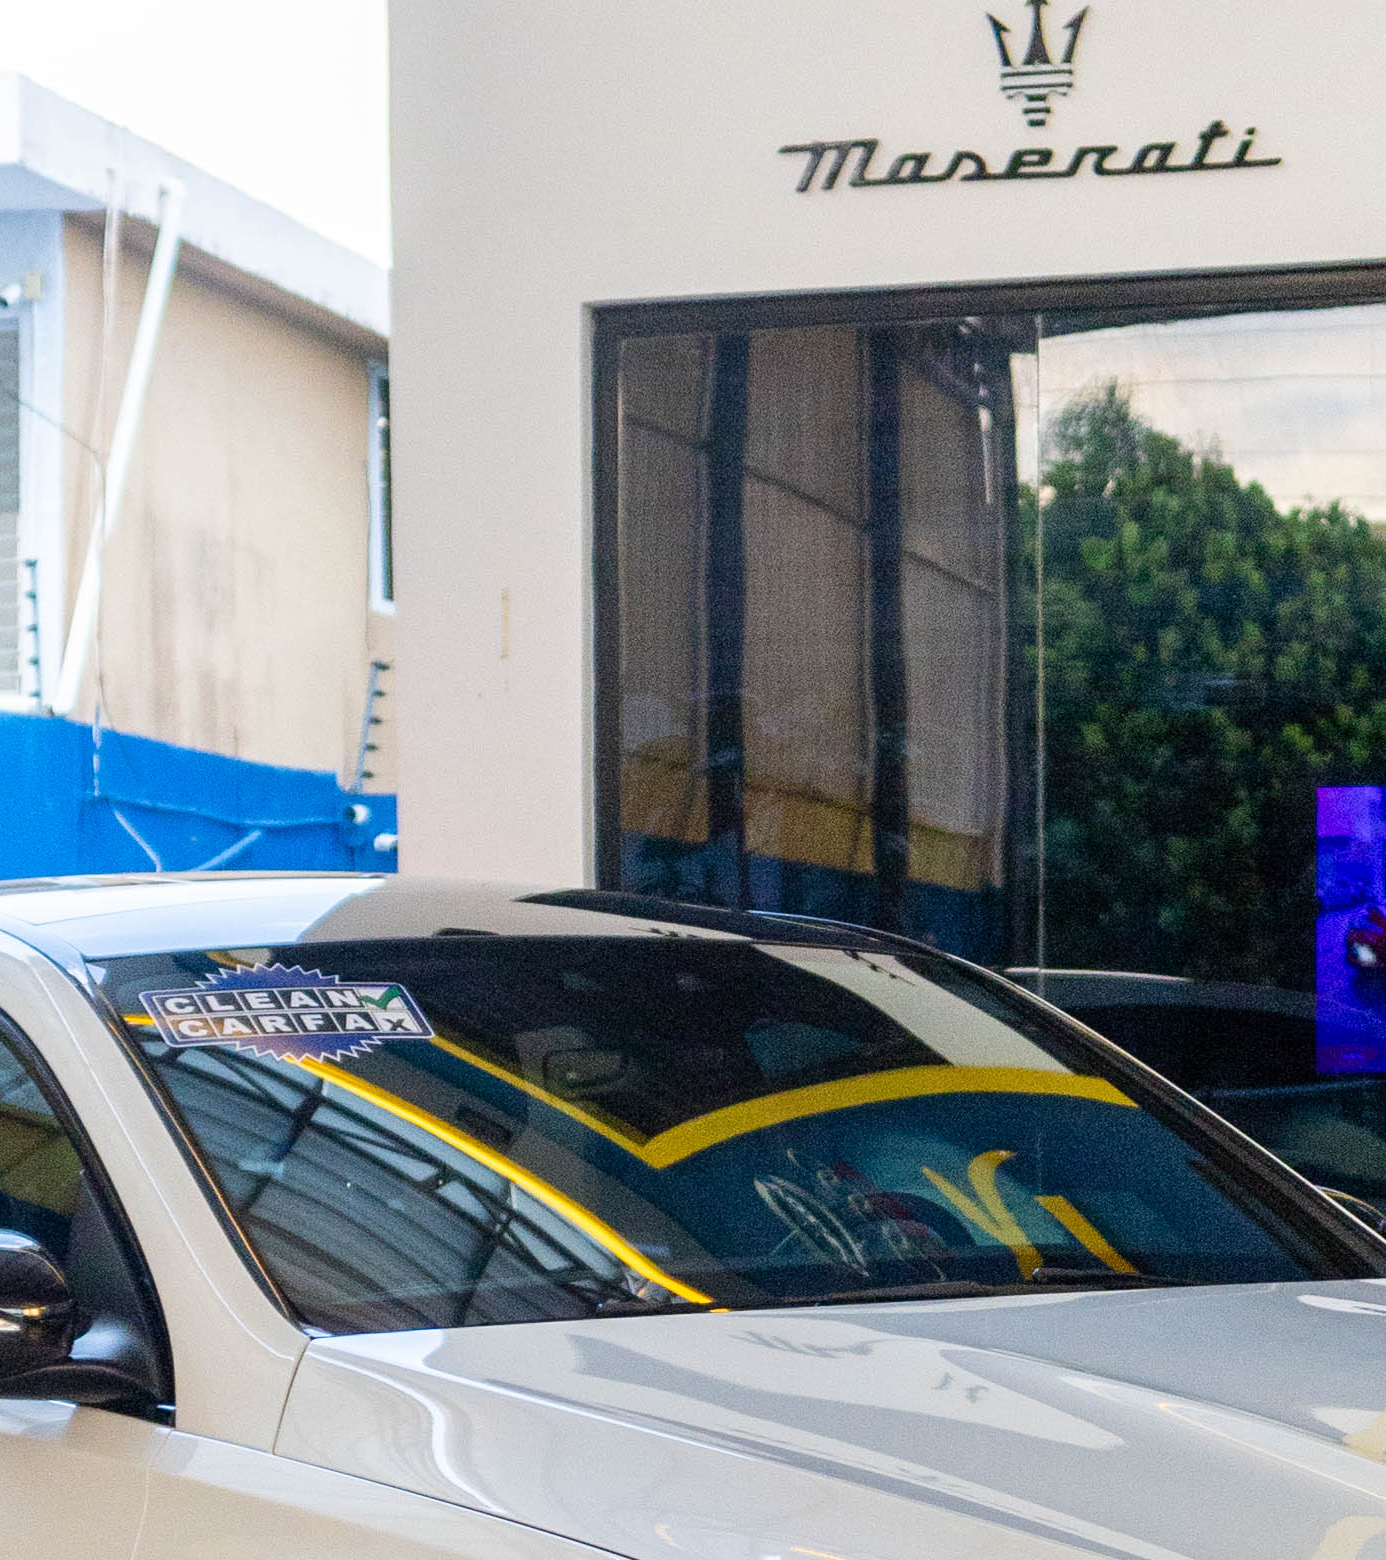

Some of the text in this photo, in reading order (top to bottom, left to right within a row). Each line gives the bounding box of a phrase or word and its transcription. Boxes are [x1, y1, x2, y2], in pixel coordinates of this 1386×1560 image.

[779, 121, 1282, 193] Maserati
[163, 987, 361, 1015] CLEAN
[176, 1013, 416, 1040] CARFAX
